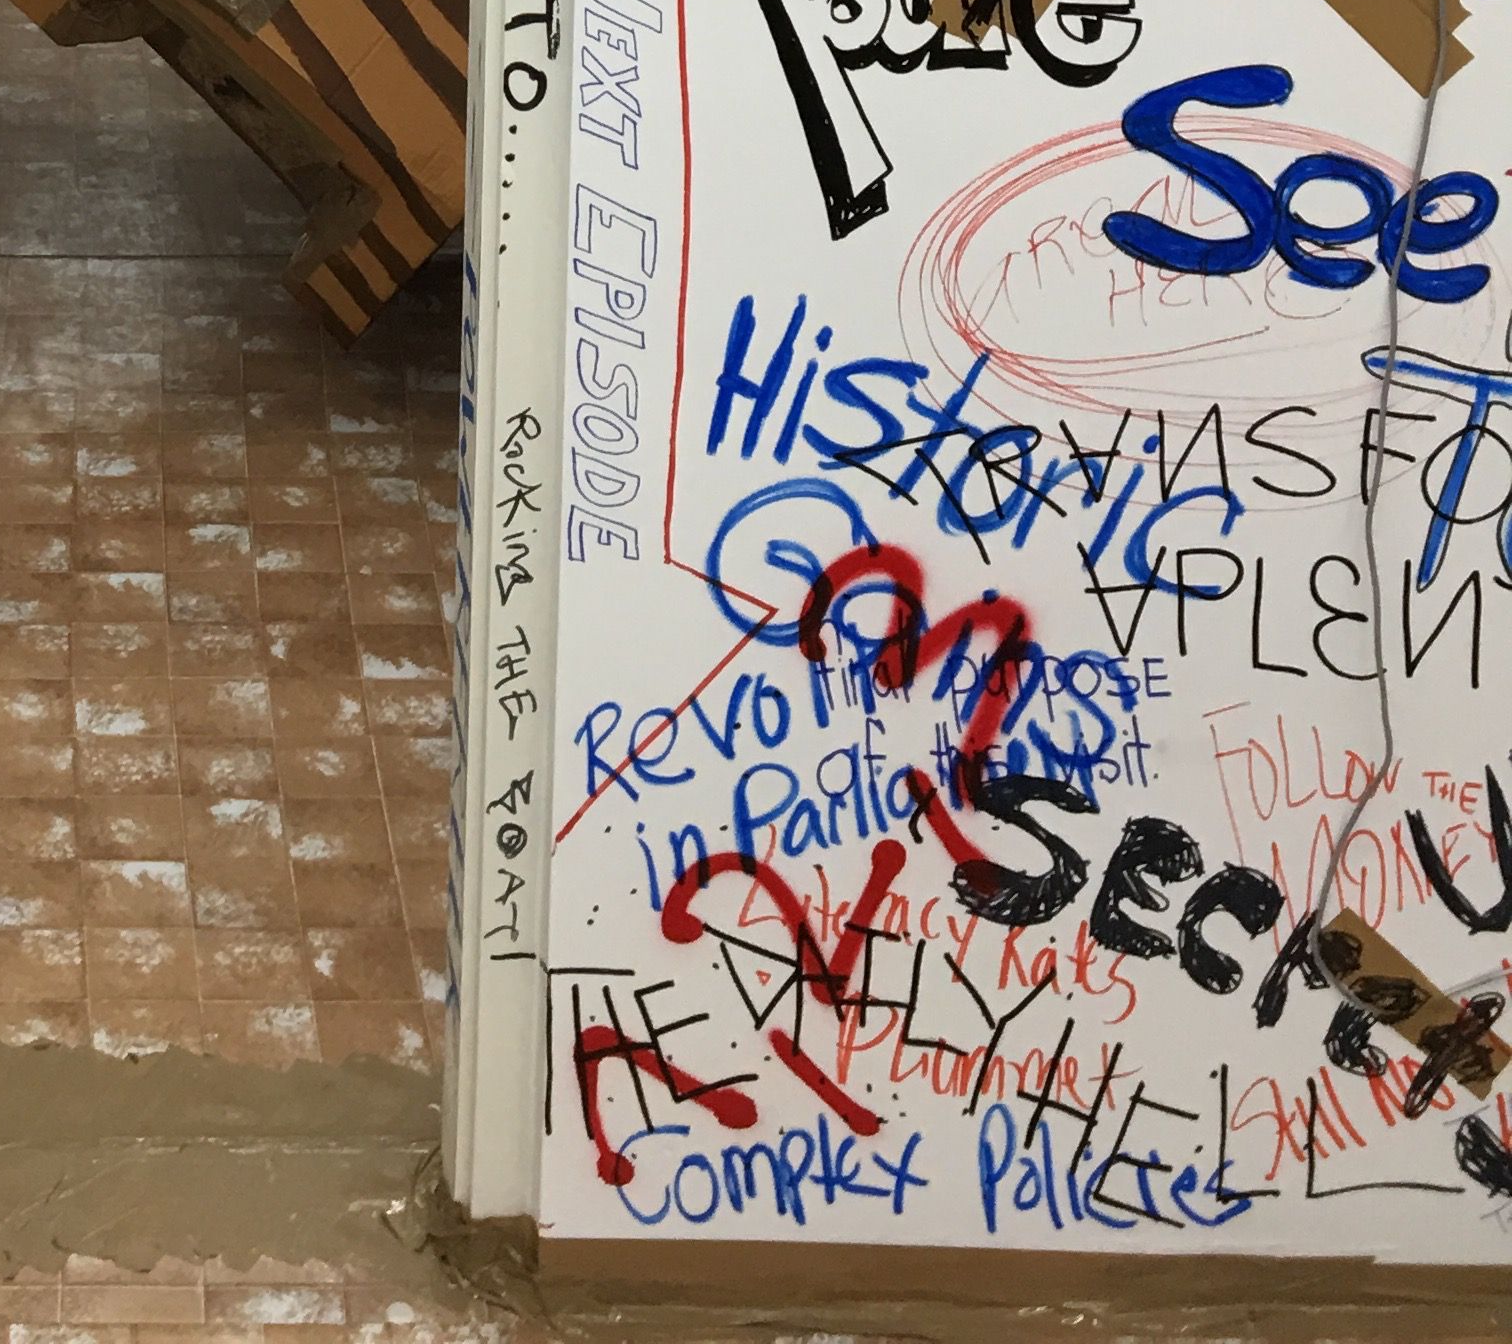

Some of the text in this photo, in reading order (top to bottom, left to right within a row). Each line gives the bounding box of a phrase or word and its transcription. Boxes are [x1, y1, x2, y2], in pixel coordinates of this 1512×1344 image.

[1100, 62, 1501, 306] See
[565, 181, 659, 564] EPISODE
[493, 623, 540, 743] THE
[1422, 770, 1484, 814] THE
